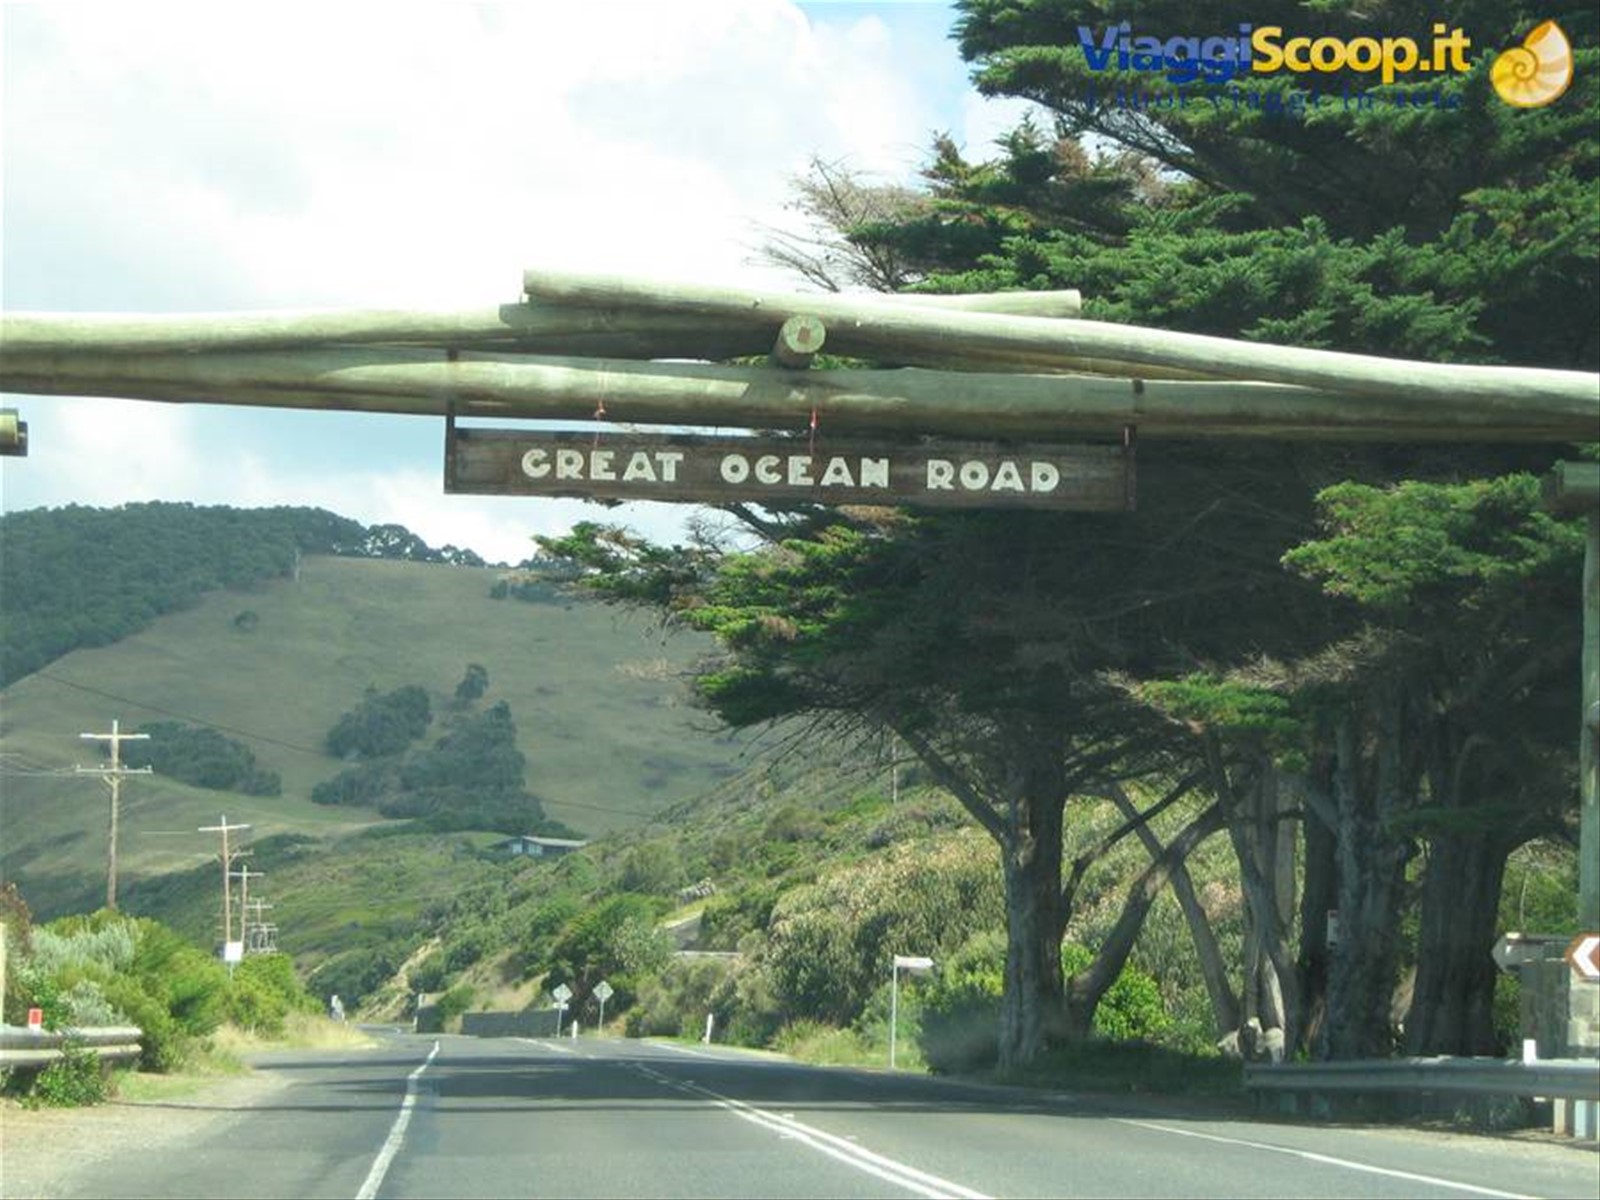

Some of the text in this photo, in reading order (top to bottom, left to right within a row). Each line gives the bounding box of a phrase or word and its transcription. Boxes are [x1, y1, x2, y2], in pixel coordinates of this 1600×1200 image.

[521, 448, 1060, 492] GREAT OCEAN ROAD
